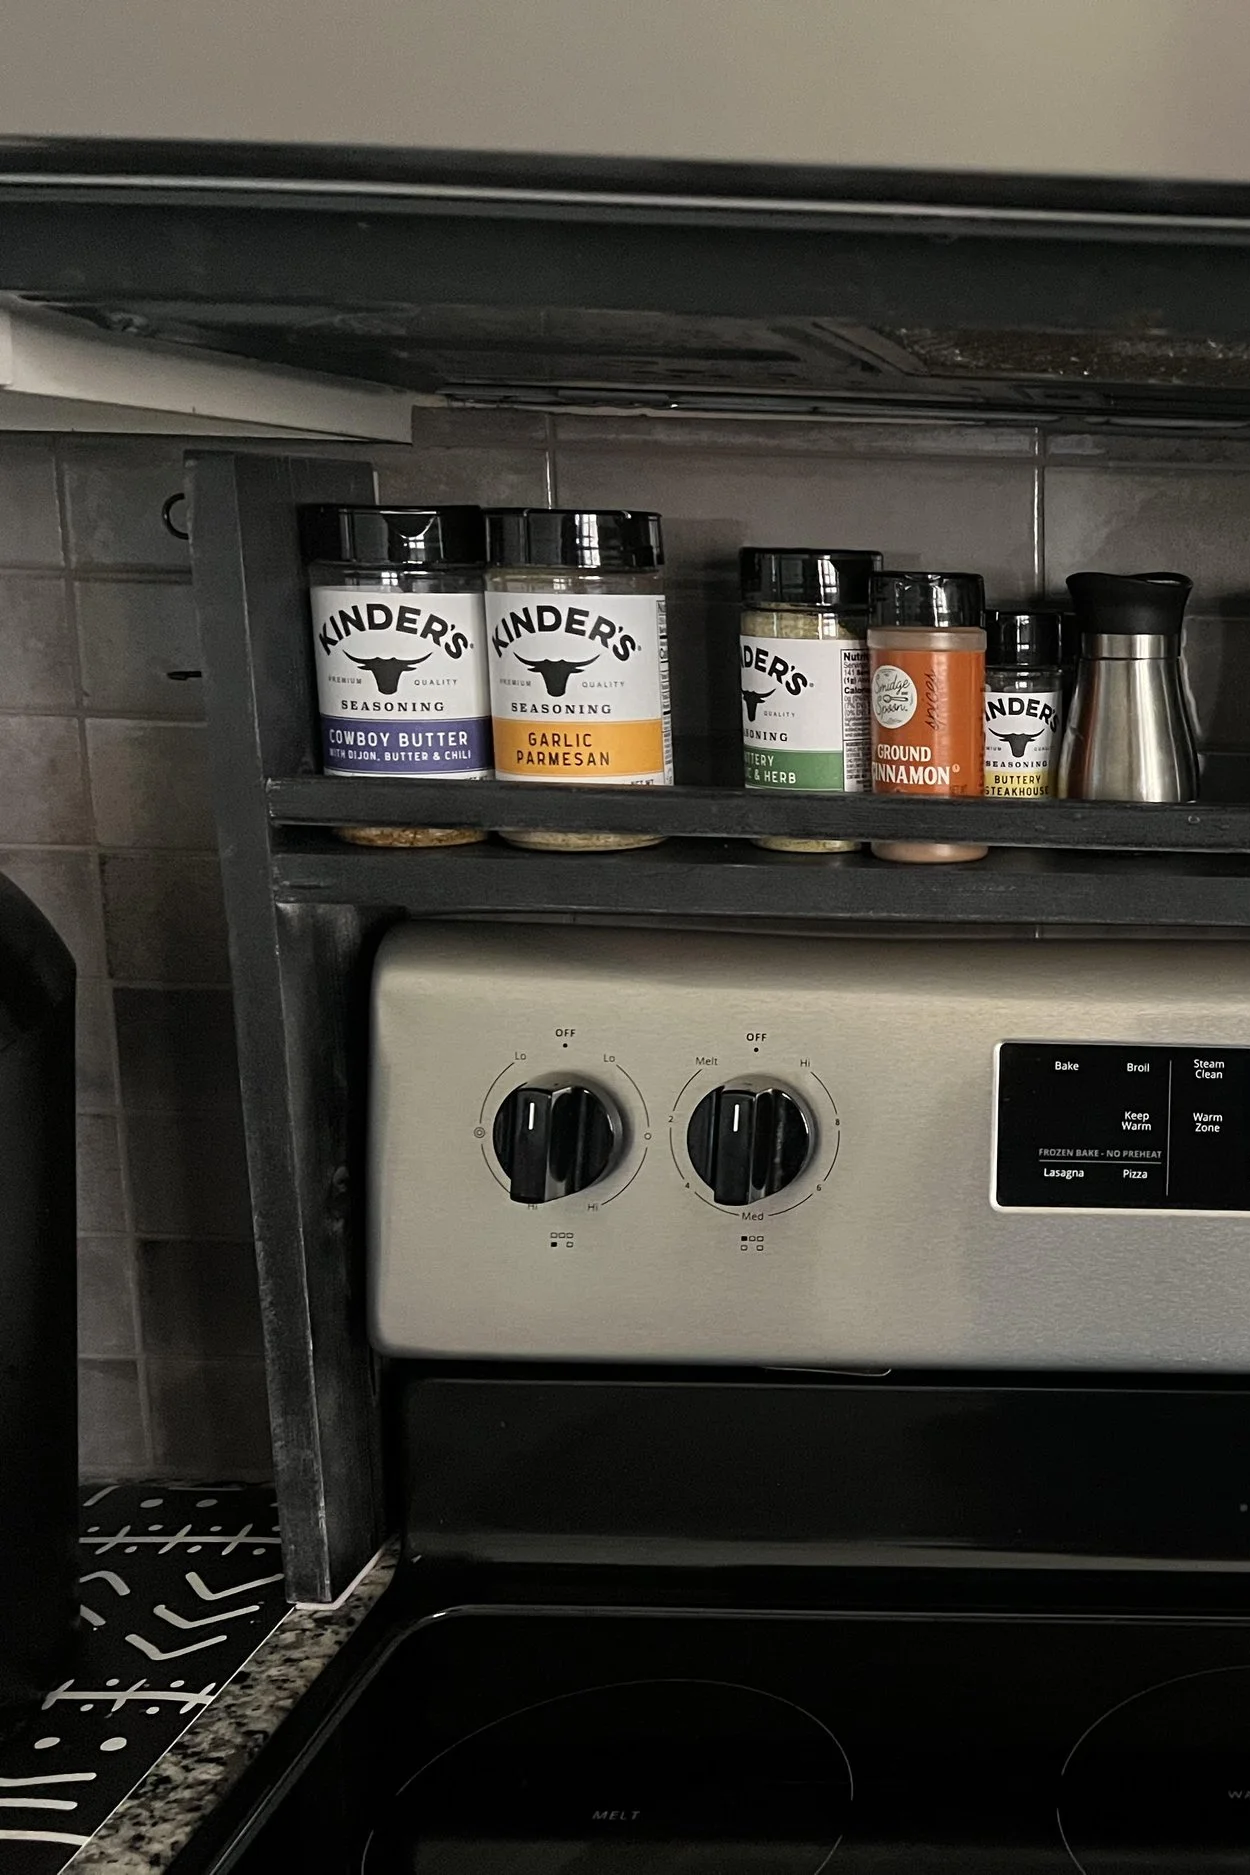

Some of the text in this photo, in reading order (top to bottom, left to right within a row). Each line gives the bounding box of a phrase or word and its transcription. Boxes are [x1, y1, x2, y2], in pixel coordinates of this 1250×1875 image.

[319, 603, 469, 660] KINDER'S
[492, 605, 636, 661] KINDER'S
[741, 645, 808, 696] DER'S
[874, 675, 910, 695] Smudge
[341, 700, 444, 712] SEASONING
[511, 702, 612, 714] SEASONING
[329, 729, 468, 747] COWBOY BUTTER
[528, 732, 592, 747] GARLIC
[384, 751, 429, 761] BUTTER
[433, 751, 441, 761] &
[444, 750, 471, 760] CHILI
[516, 750, 610, 766] PARMESAN
[878, 744, 932, 762] GROUND
[985, 760, 1048, 768] SEASONING
[764, 771, 796, 784] HERB
[994, 775, 1041, 784] BUTTERY
[985, 785, 1049, 796] STEAKHOUSE
[555, 1028, 576, 1038] OFF
[746, 1033, 767, 1042] OFF
[514, 1051, 527, 1060] Lo
[603, 1053, 616, 1062] Lo
[695, 1056, 718, 1066] Melt
[800, 1058, 811, 1068] Hi
[1054, 1061, 1080, 1071] Bake
[1193, 1059, 1225, 1069] Steam
[1126, 1062, 1150, 1072] Broil
[1195, 1069, 1223, 1079] Clean
[668, 1115, 674, 1124] 2
[835, 1117, 841, 1126] 8
[1124, 1111, 1150, 1122] Keep
[1192, 1112, 1223, 1122] Warm
[1121, 1121, 1152, 1131] Warm
[1195, 1123, 1221, 1133] Zone
[1038, 1148, 1162, 1159] FROZEN BAKE NO PREHEAT
[1043, 1168, 1085, 1180] Lasagna
[1123, 1169, 1148, 1179] Pizza
[685, 1181, 691, 1189] 4
[816, 1184, 822, 1192] 6
[587, 1202, 598, 1212] Hi
[741, 1212, 764, 1221] Med
[592, 1810, 641, 1820] MELT
